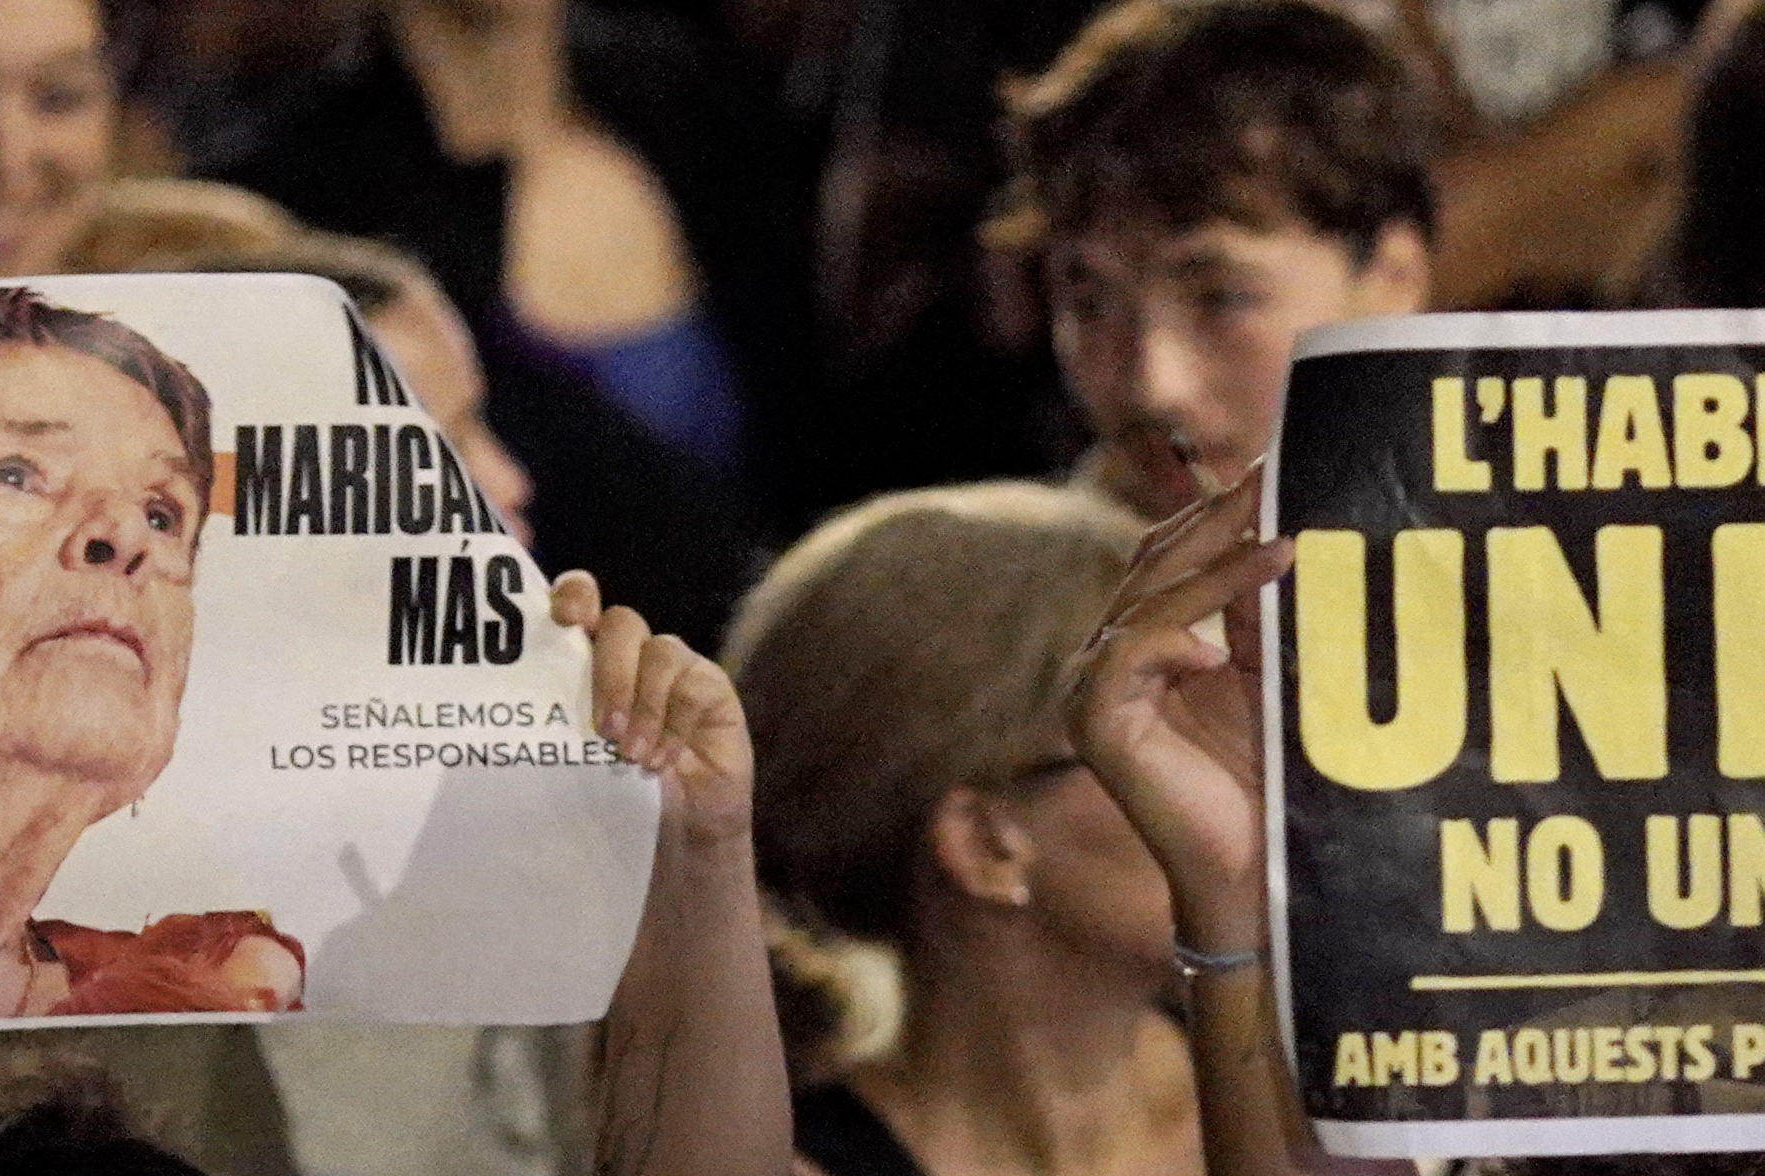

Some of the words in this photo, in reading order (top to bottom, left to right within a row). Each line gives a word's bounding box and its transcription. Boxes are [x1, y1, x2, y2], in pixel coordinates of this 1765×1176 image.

[235, 425, 506, 535] MARICA
[387, 540, 525, 665] MÁS
[1294, 523, 1668, 791] UN
[270, 745, 335, 769] LOS
[348, 740, 622, 769] RESPONSABLES
[321, 698, 535, 729] SEÑALEMOS
[545, 701, 569, 726] A
[1441, 814, 1605, 933] NO
[1333, 1029, 1460, 1088] AMB
[1475, 1025, 1717, 1085] AQUESTS
